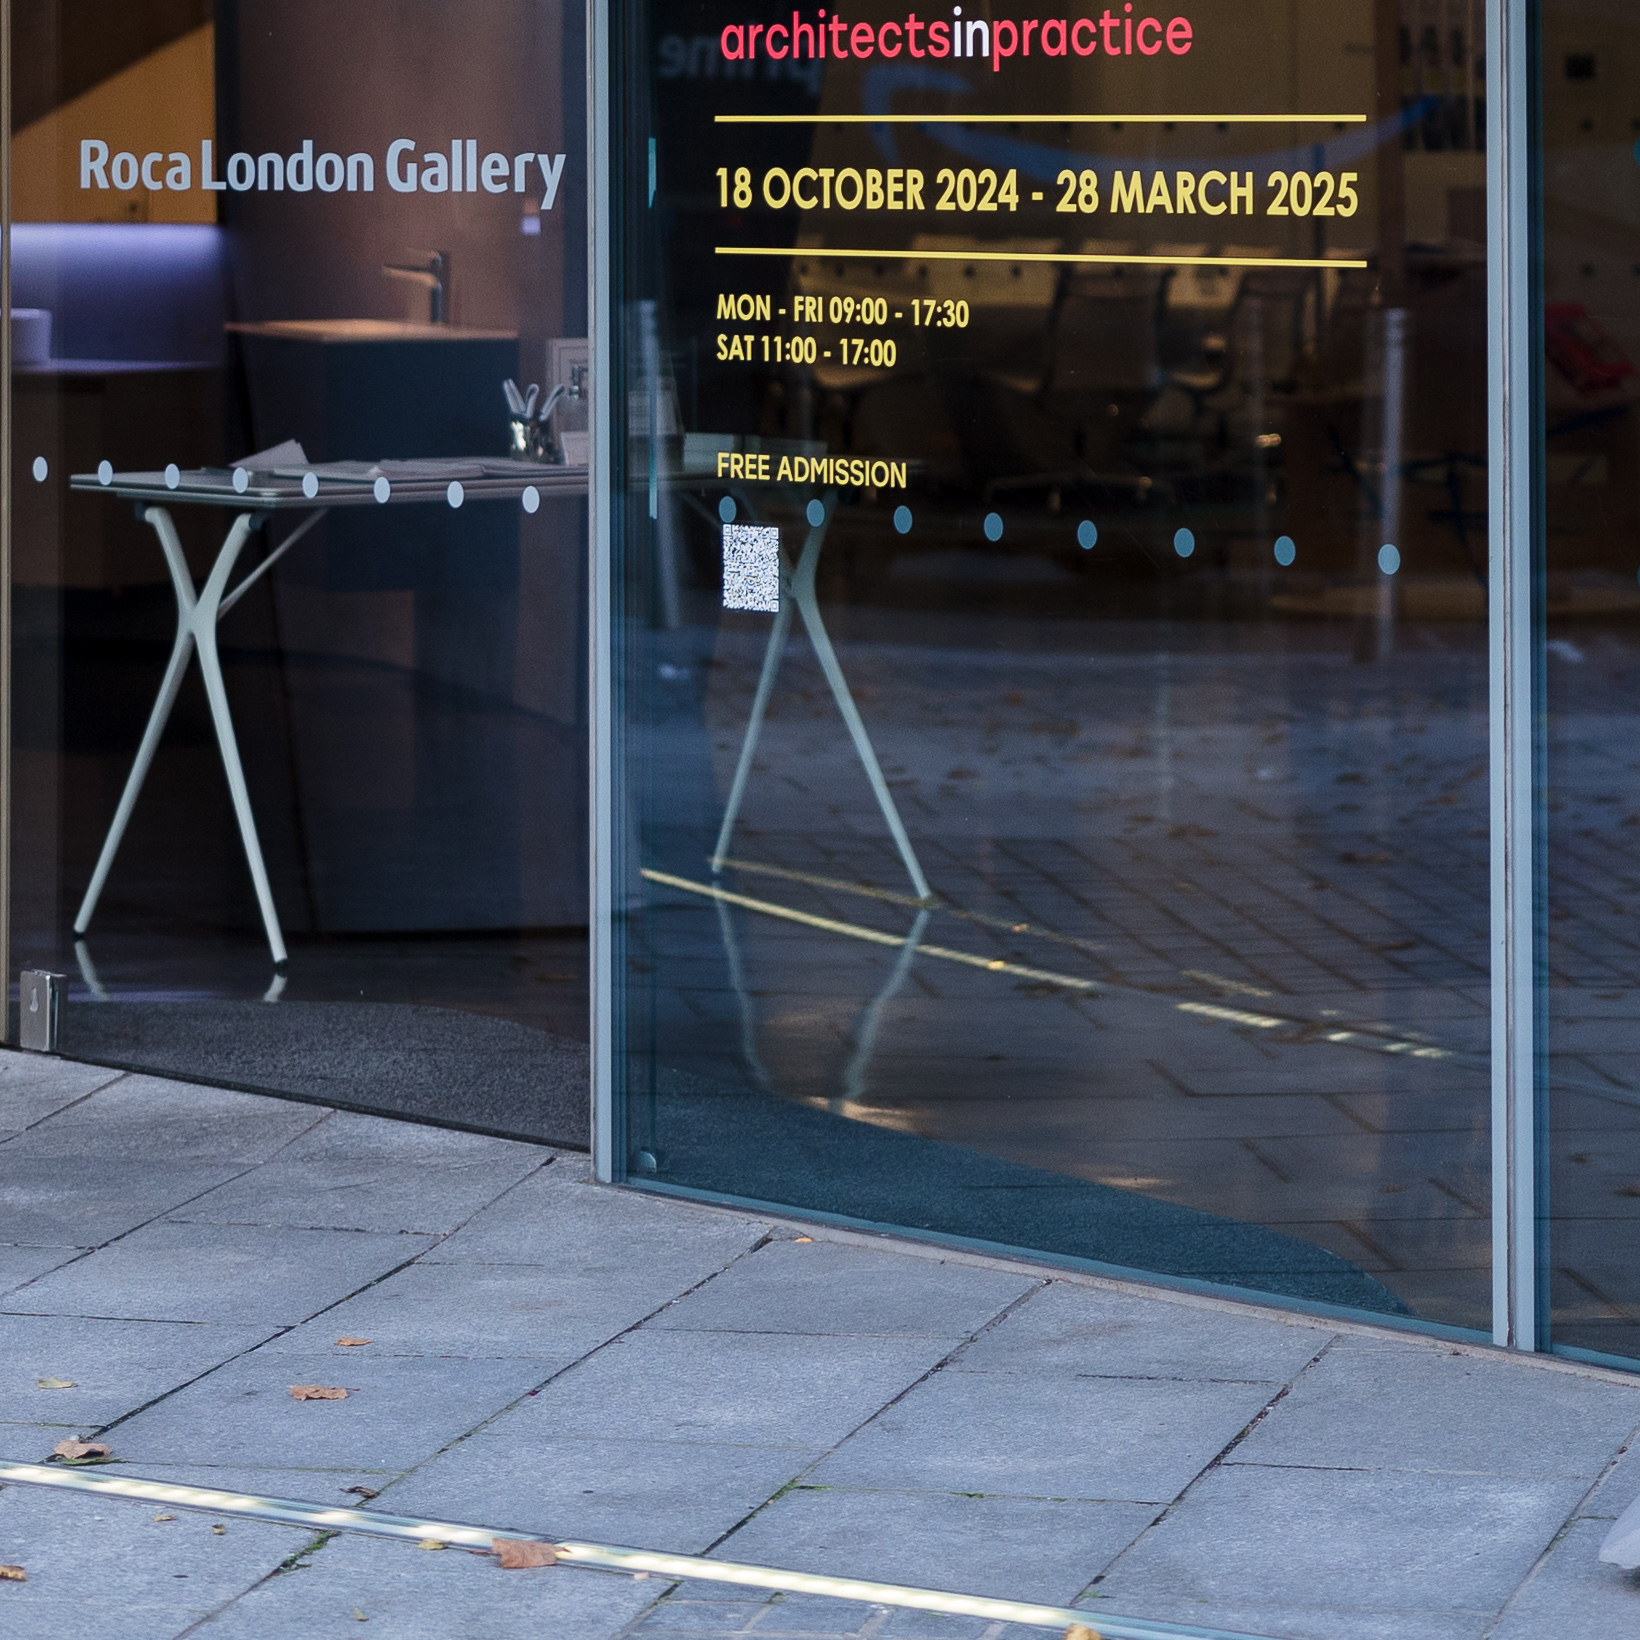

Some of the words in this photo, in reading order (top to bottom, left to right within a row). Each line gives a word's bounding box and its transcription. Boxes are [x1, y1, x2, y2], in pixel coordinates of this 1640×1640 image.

[80, 139, 191, 191] Roca
[201, 139, 374, 192] London
[385, 138, 567, 210] Gallery
[716, 166, 753, 209] 18
[762, 167, 925, 211] OCTOBER
[935, 167, 1019, 212] 2024
[1032, 191, 1044, 201] -
[1055, 168, 1100, 214] 28
[1109, 169, 1254, 216] MARCH
[1266, 171, 1359, 218] 2025
[716, 293, 771, 321] MON
[793, 295, 823, 323] FRI
[829, 296, 888, 326] 09:00
[911, 298, 970, 329] 17:30
[716, 333, 754, 361] SAT
[762, 335, 817, 365] 11:00
[840, 338, 897, 368] 17:00
[717, 452, 770, 481] FREE
[777, 455, 907, 490] ADMISSION
